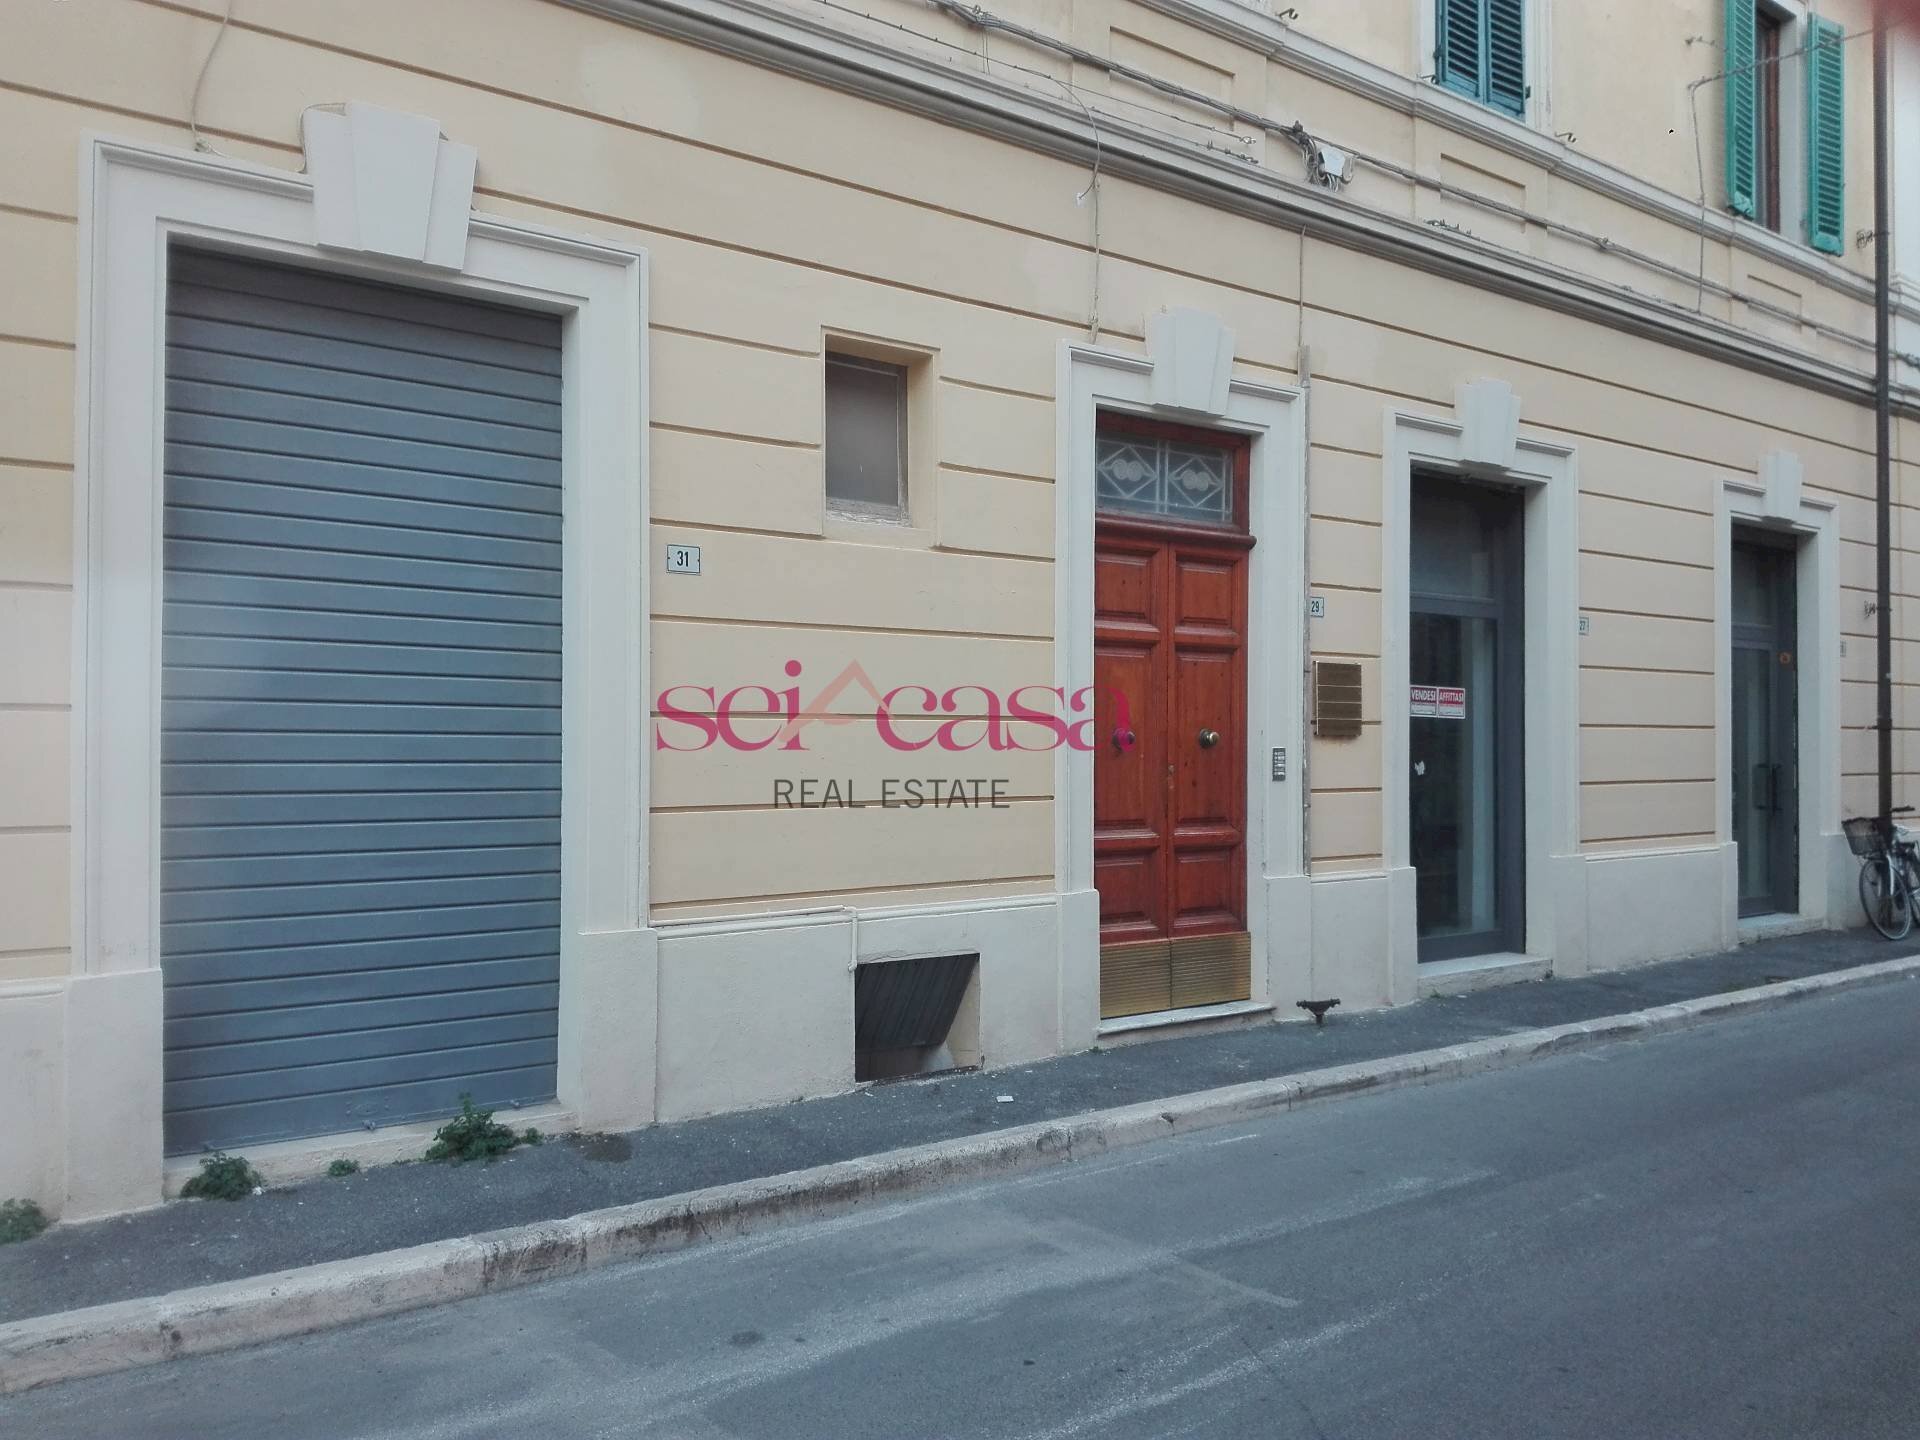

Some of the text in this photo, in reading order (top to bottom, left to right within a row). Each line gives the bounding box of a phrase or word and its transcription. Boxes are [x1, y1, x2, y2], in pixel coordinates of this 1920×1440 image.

[677, 550, 689, 567] 31
[1311, 600, 1320, 613] 29
[1411, 689, 1436, 702] VENDESI
[1440, 691, 1464, 703] AFFITTASI
